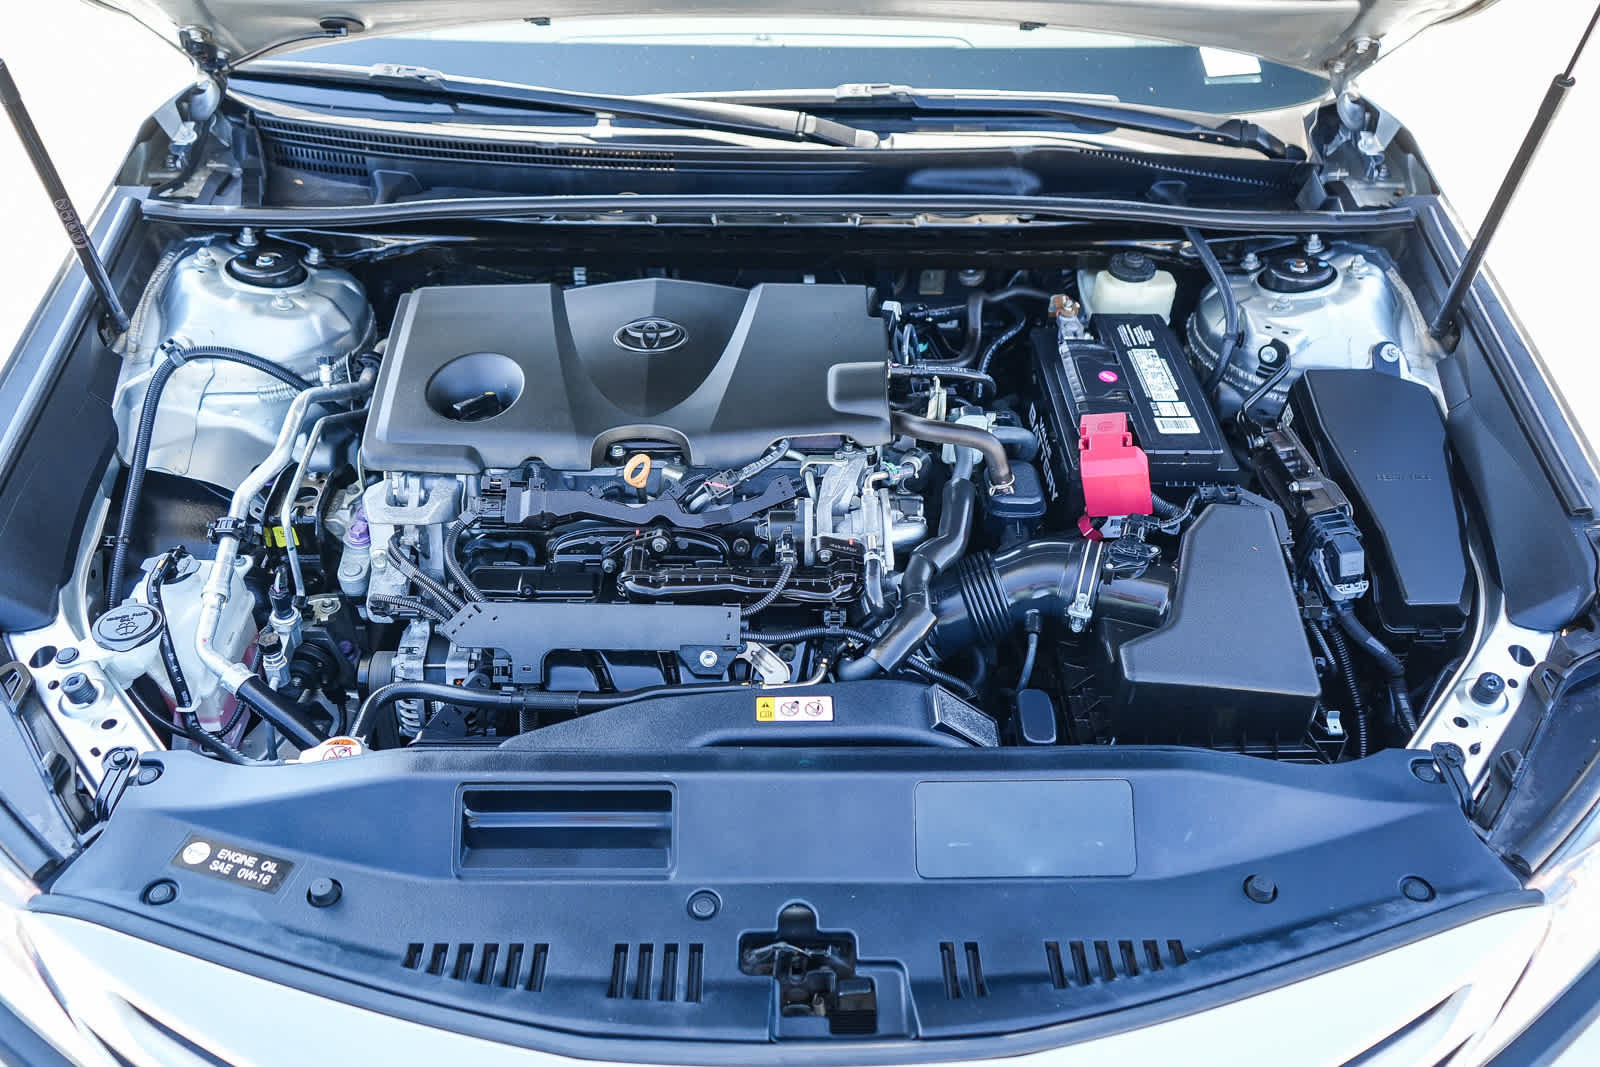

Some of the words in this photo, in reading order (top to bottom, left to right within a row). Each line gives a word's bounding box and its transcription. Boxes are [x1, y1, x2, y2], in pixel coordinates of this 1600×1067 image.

[209, 860, 234, 874] SAE
[217, 848, 258, 868] ENGINE
[261, 860, 278, 874] OIL
